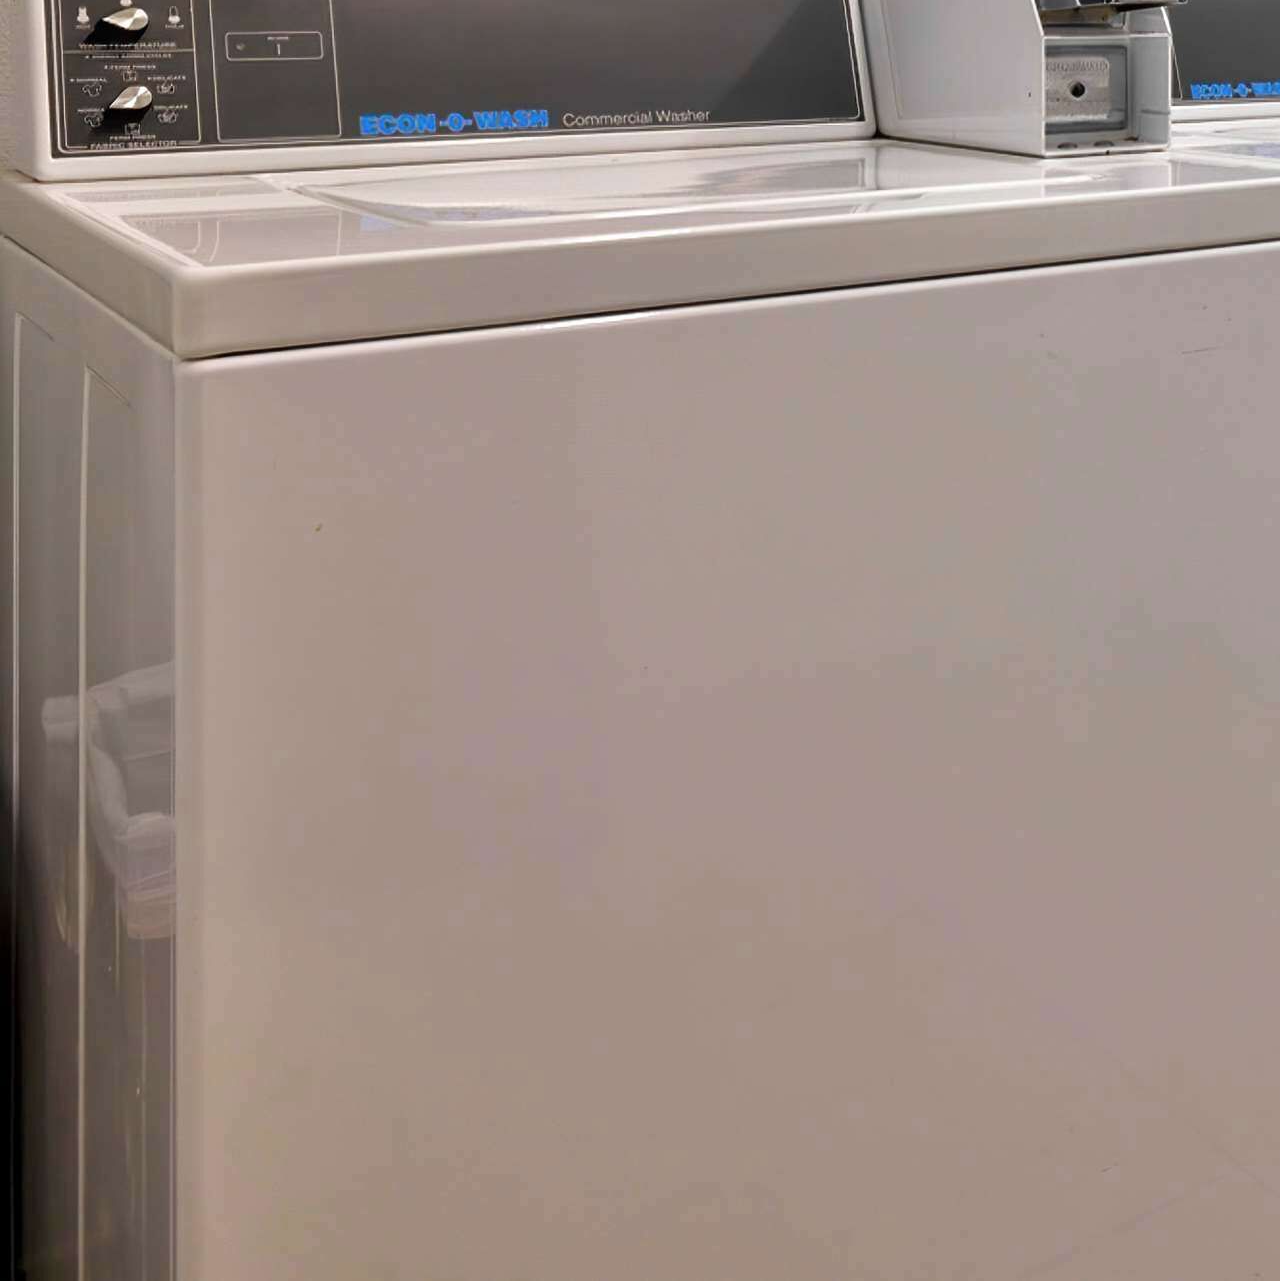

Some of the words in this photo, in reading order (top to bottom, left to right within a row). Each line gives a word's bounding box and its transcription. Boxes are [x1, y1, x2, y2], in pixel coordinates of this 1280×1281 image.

[359, 109, 549, 136] ECON-O-WASH
[562, 111, 653, 128] Commercial
[657, 109, 711, 124] Washer
